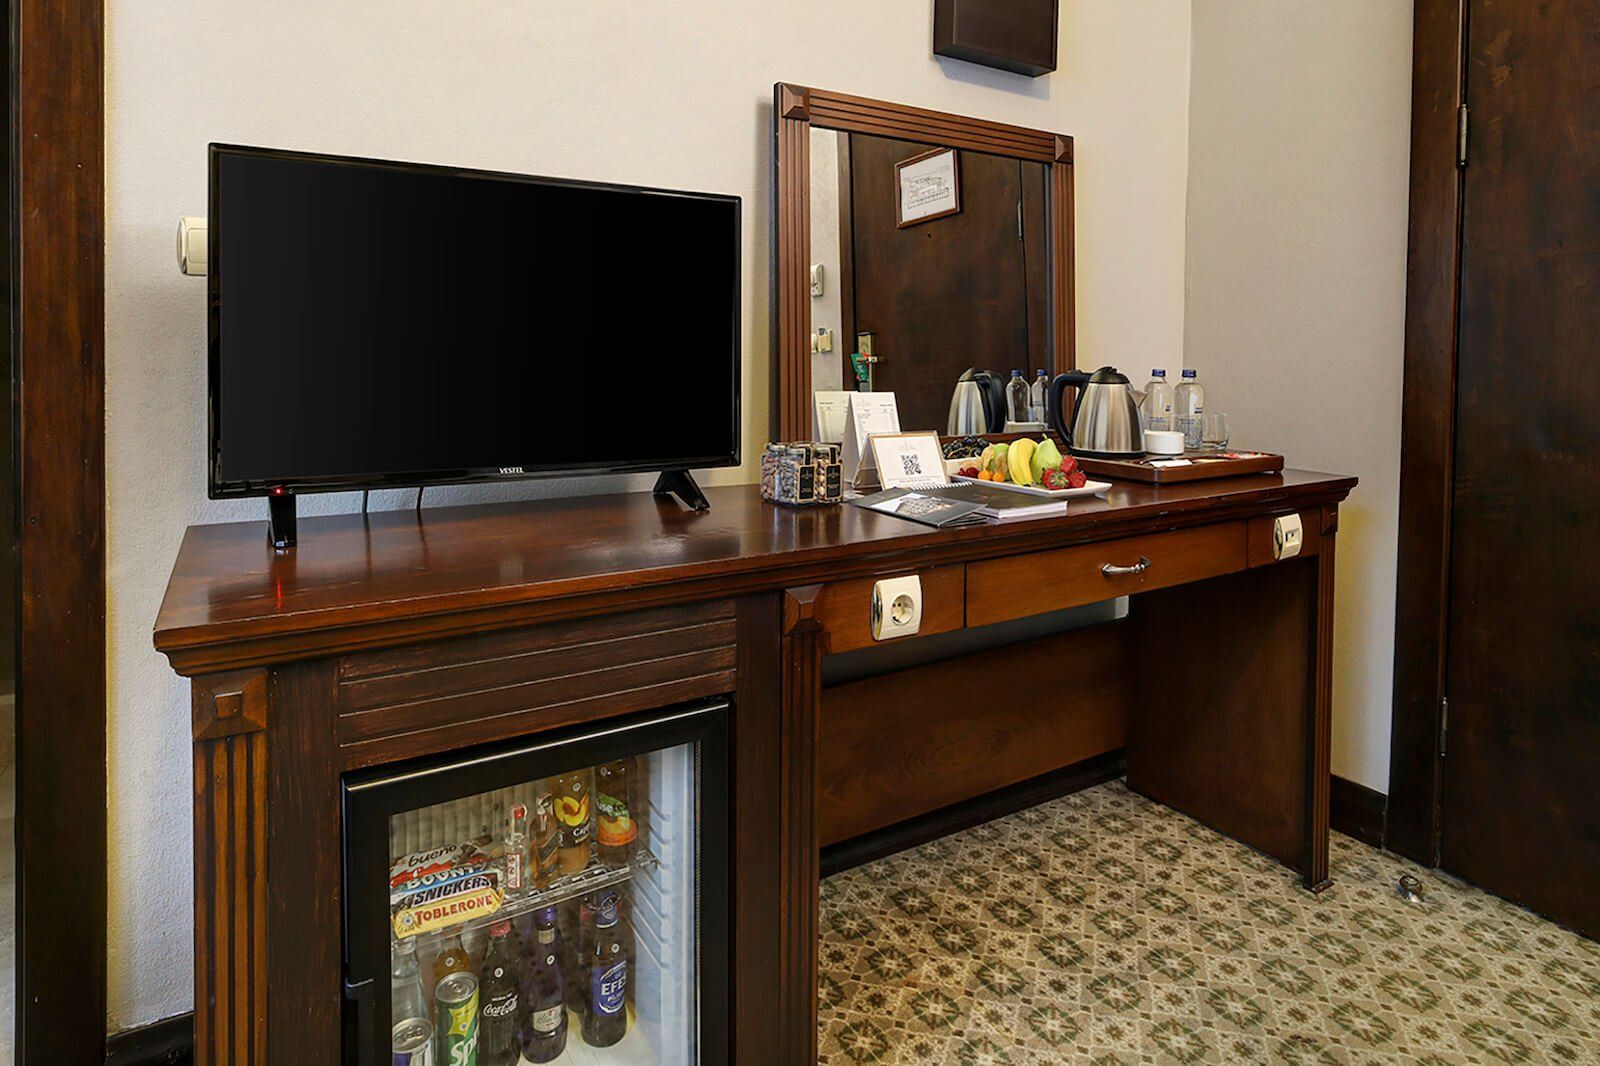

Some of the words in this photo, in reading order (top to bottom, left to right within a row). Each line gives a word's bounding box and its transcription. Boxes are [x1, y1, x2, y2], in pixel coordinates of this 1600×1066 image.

[408, 845, 457, 868] bueno
[413, 876, 492, 906] SNICKERS
[415, 895, 493, 926] TOBLERONE
